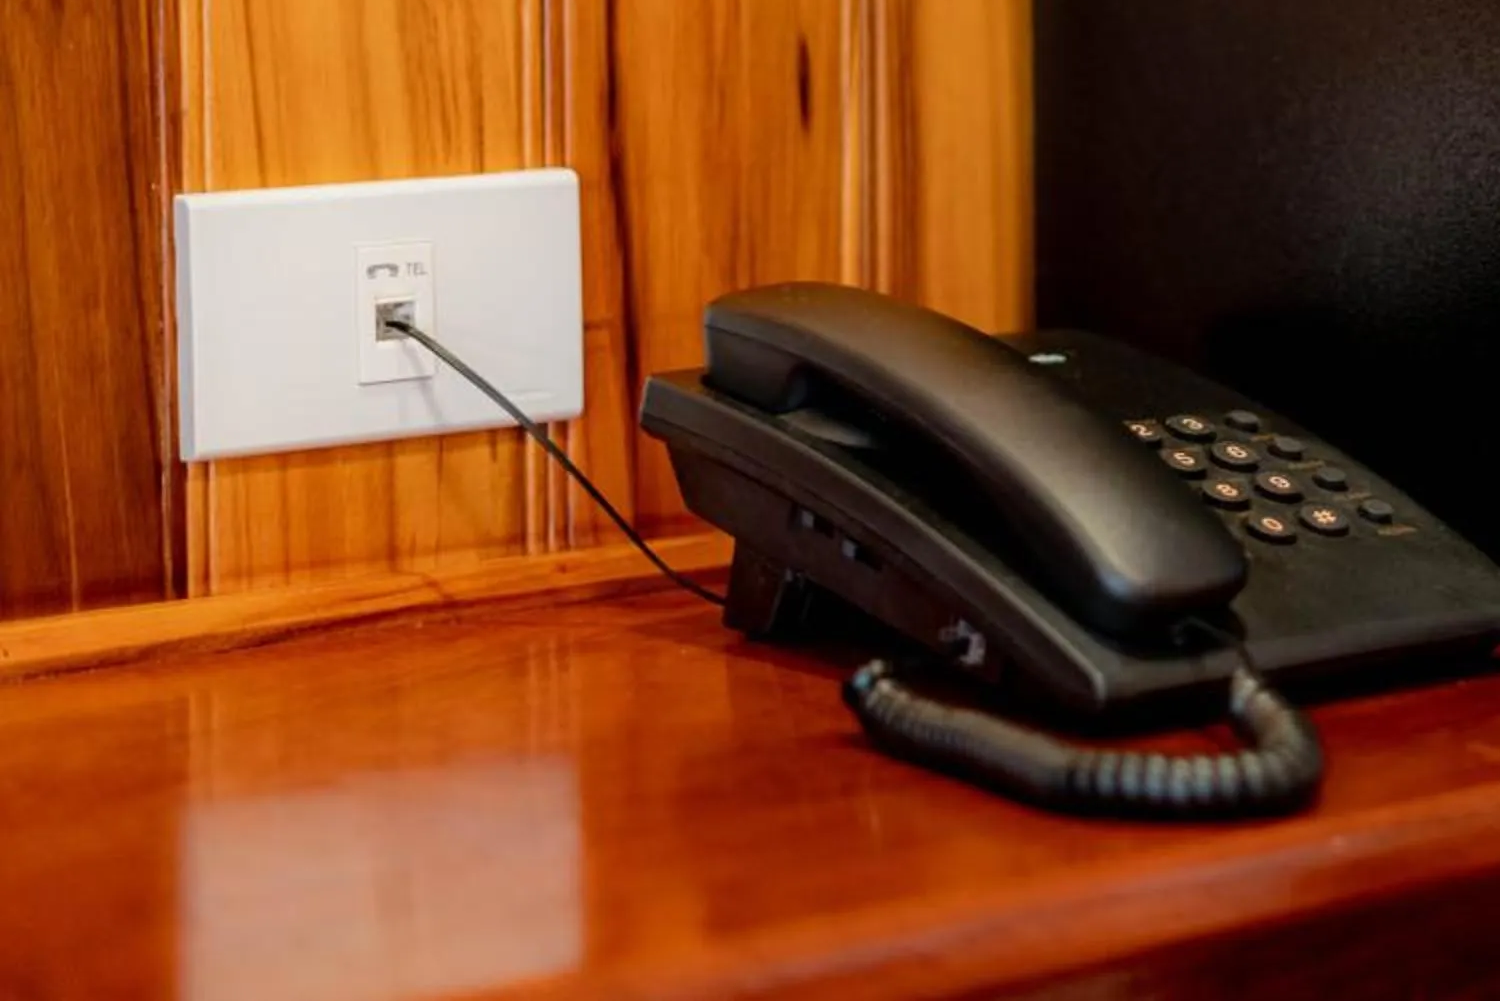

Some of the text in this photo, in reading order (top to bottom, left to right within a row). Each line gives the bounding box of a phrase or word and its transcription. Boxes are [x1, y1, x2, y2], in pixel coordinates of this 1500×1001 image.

[406, 262, 428, 275] TEL
[1130, 424, 1152, 438] 2
[1173, 445, 1248, 466] 5 6
[1215, 476, 1291, 498] 8 9
[1261, 516, 1284, 532] 0
